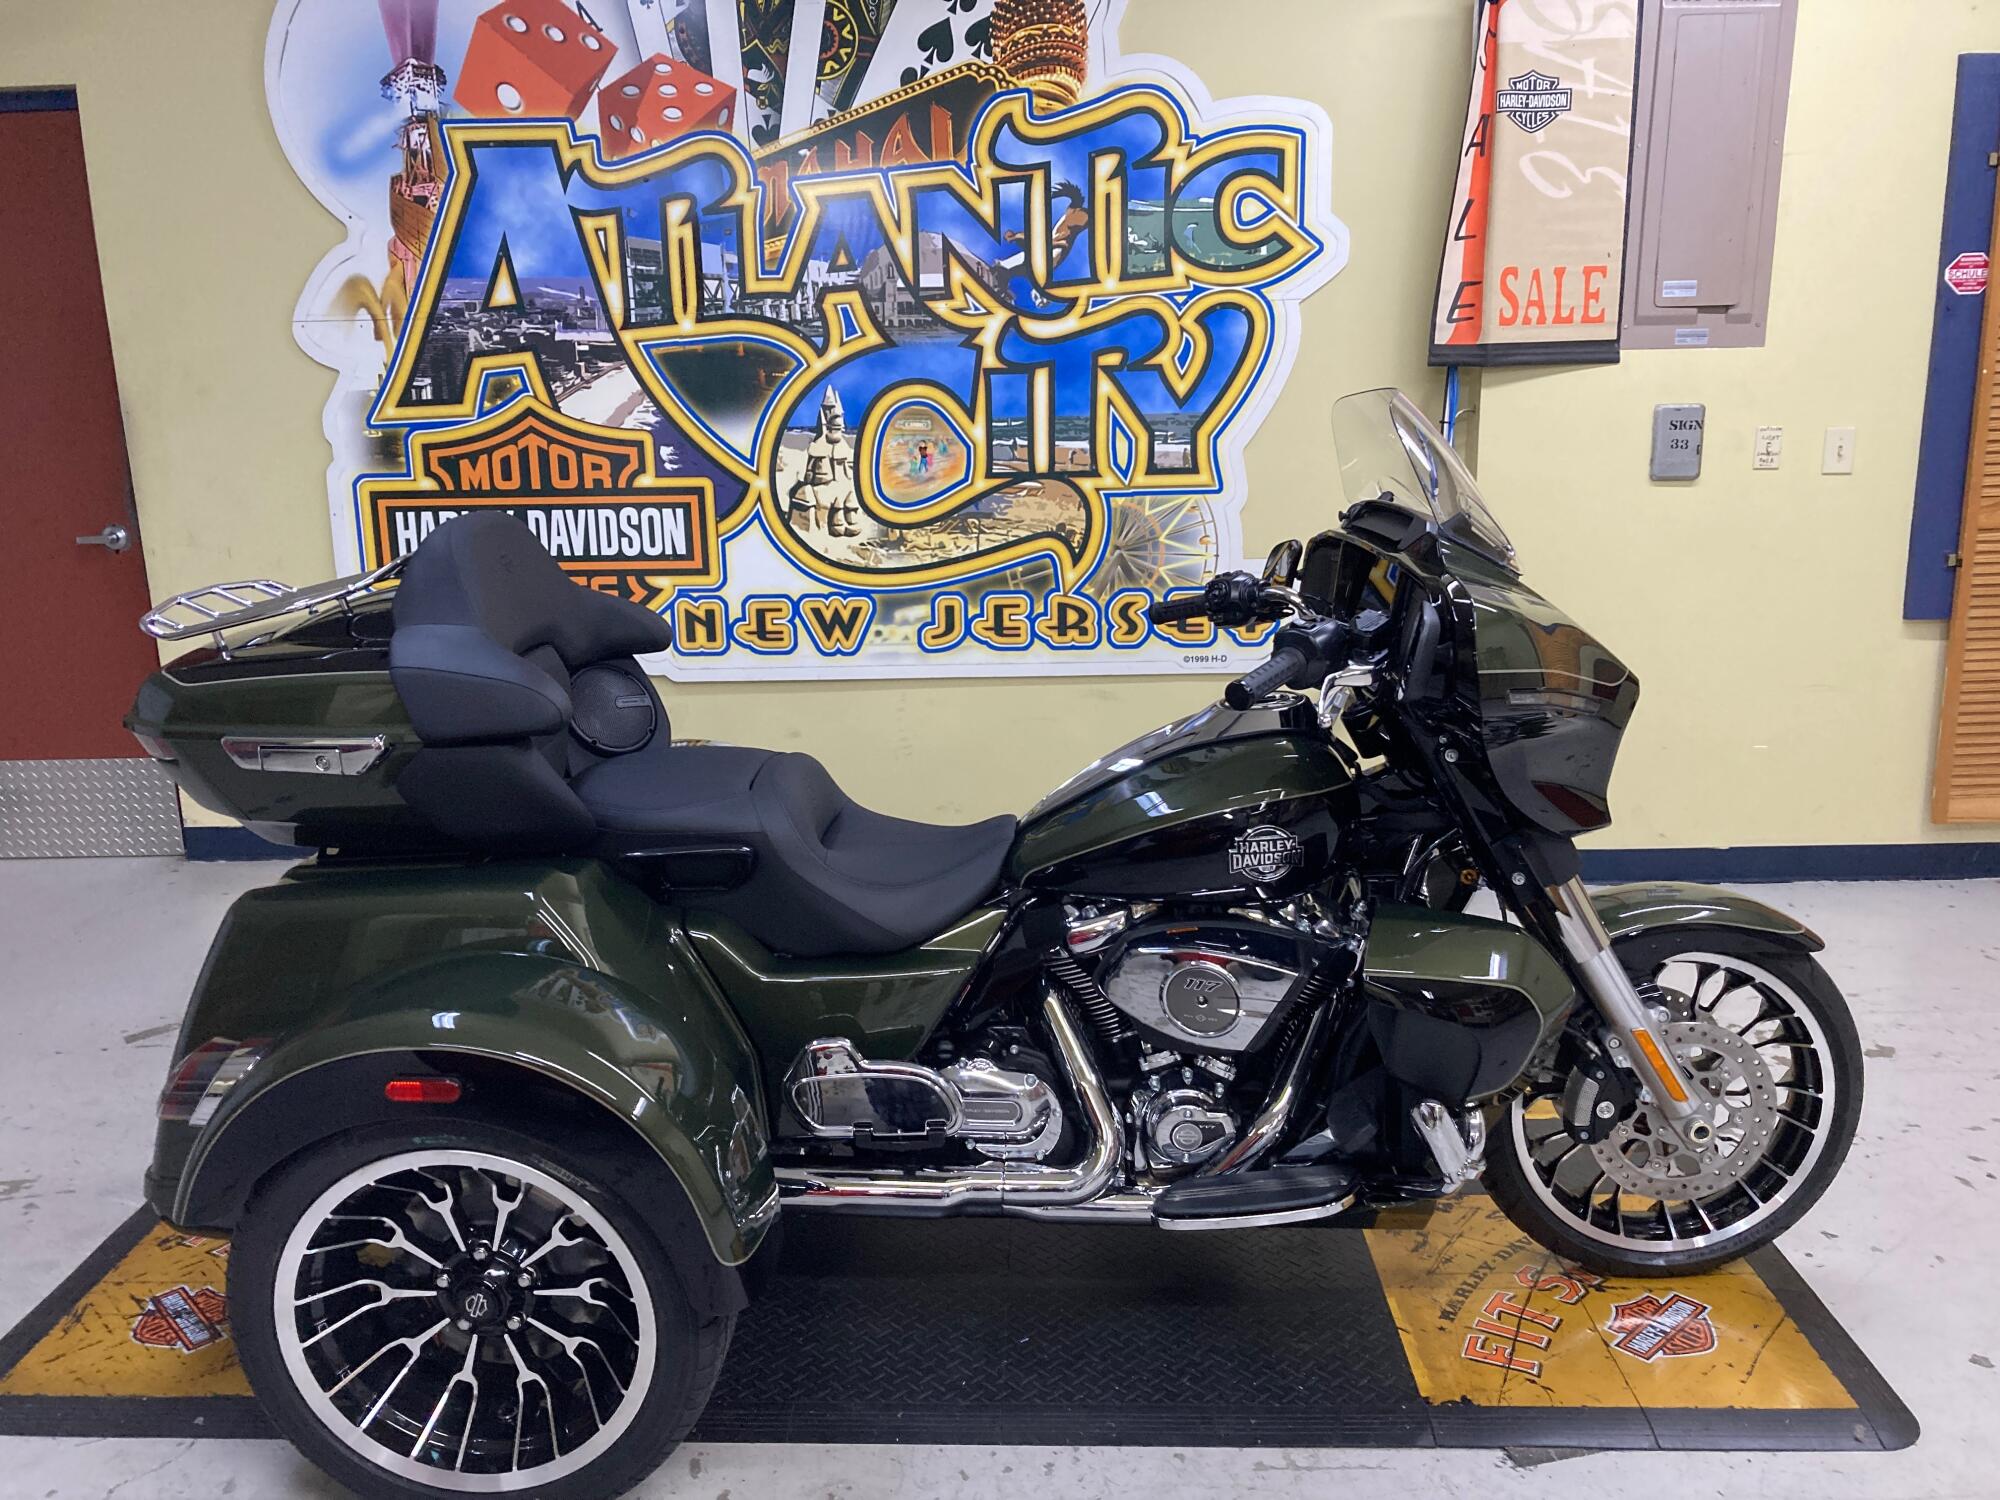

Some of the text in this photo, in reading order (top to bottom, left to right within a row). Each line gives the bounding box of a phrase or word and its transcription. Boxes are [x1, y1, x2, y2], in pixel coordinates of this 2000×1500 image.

[1516, 76, 1551, 90] MOTOR
[1500, 94, 1567, 109] HARLEY-DAVIDSON
[1515, 111, 1549, 128] CYCLES
[370, 88, 1318, 422] ATLANTIC
[1498, 265, 1608, 327] SALE
[1668, 420, 1704, 431] SIGN
[757, 290, 1268, 592] CITY
[1670, 439, 1689, 450] 33
[459, 433, 613, 491] MOTOR
[677, 598, 870, 653] NEW
[1211, 655, 1228, 663] H-D
[1239, 839, 1294, 854] HARLEY
[1232, 850, 1303, 870] DAVIDSON
[1183, 978, 1223, 992] 117
